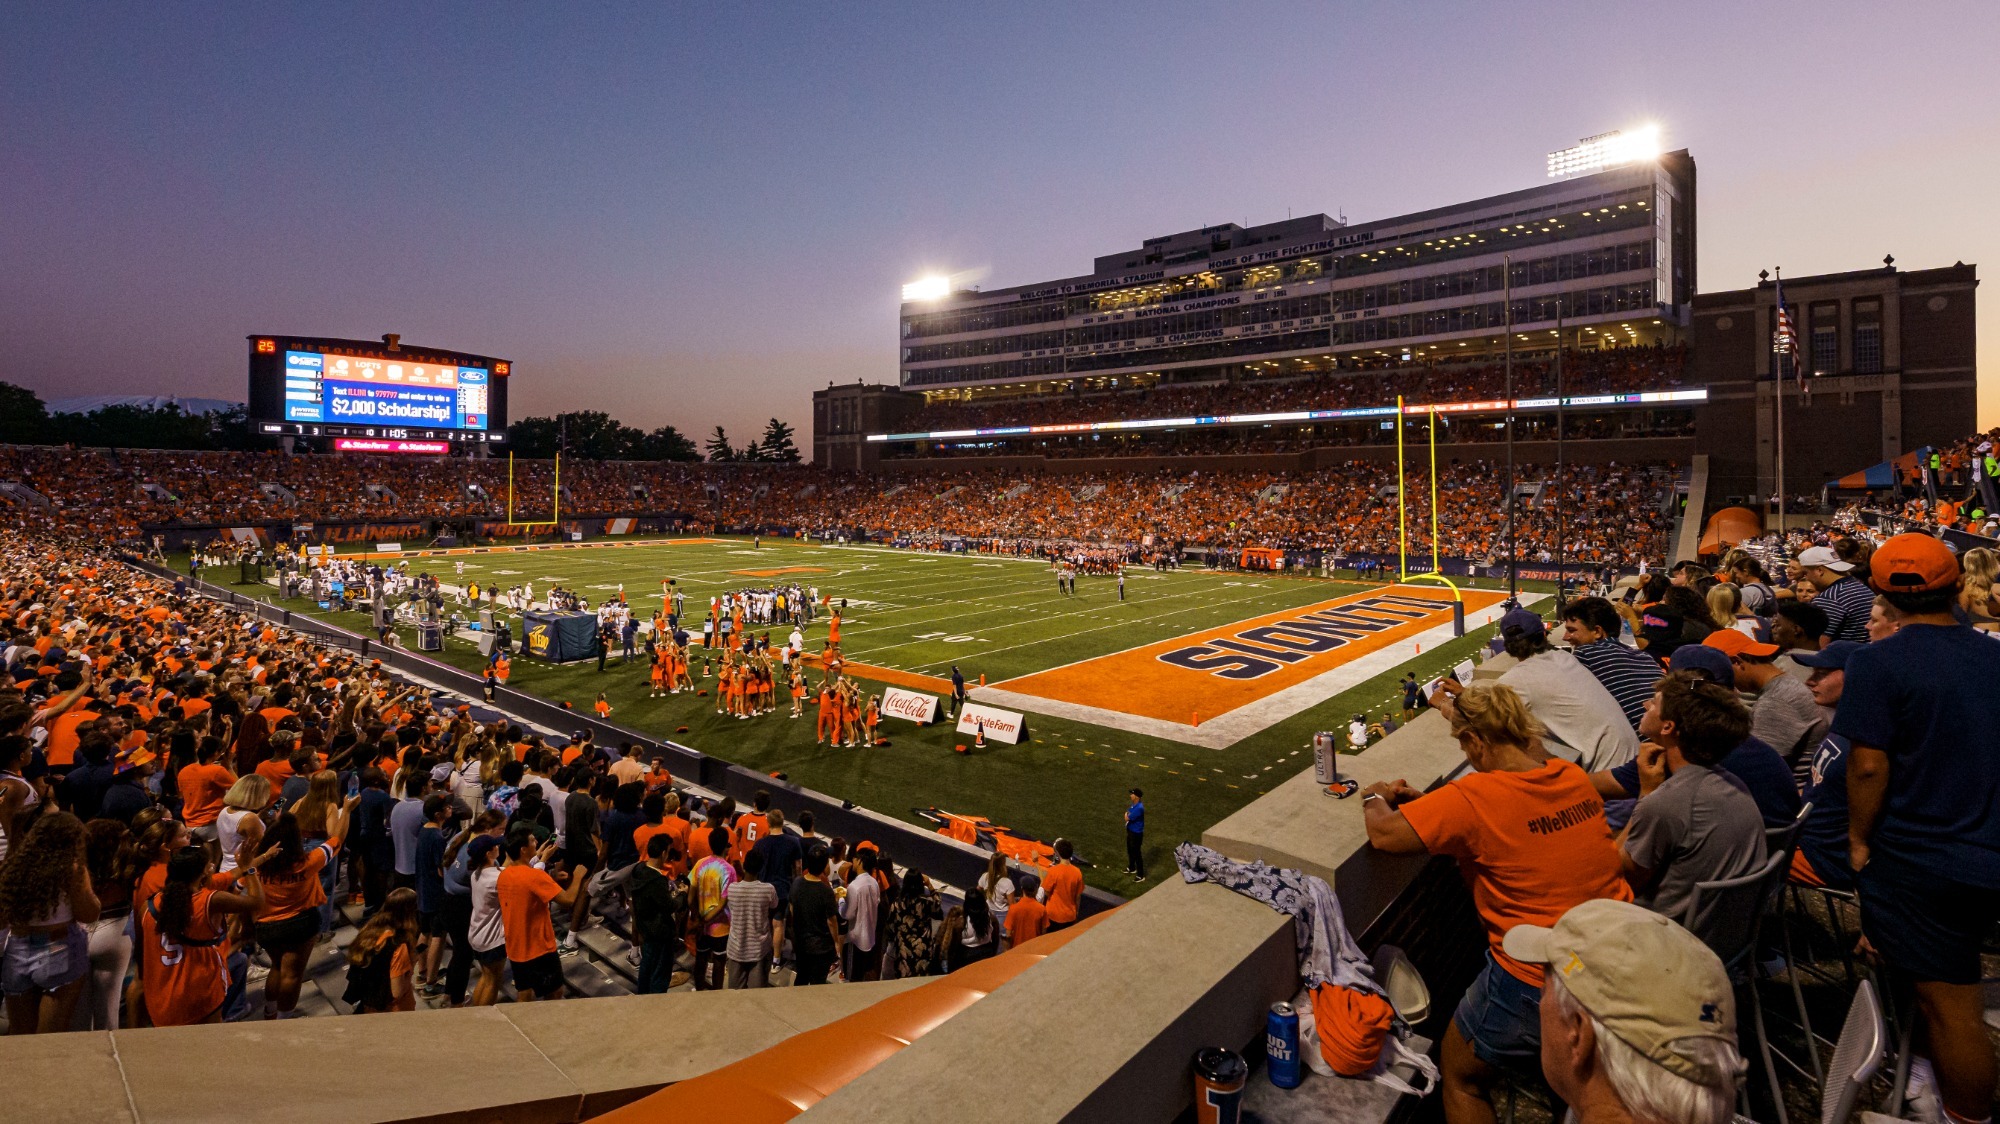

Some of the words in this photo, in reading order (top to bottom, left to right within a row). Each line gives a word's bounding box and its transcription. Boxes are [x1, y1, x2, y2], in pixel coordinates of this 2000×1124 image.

[1208, 258, 1238, 269] HOME
[1241, 255, 1255, 264] OF
[1257, 250, 1278, 261] THE
[1281, 239, 1334, 256] FIGHTING
[1338, 232, 1373, 246] ILLINI
[1020, 287, 1058, 299] WELCOME
[1061, 285, 1072, 293] TO
[1074, 278, 1120, 291] MEMORIAL
[1123, 271, 1164, 283] STADIUM
[1135, 305, 1180, 318] NATIONAL
[1183, 296, 1240, 311] CHAMPIONS
[1168, 328, 1224, 342] CHAMPIONS
[259, 341, 275, 352] 25
[291, 343, 386, 359] MEMORIAL
[407, 354, 482, 367] STADIUM
[355, 360, 381, 370] LOFTS
[495, 363, 508, 373] 25
[332, 387, 347, 396] Text
[348, 388, 366, 397] ILLINI
[375, 390, 397, 399] 979797
[332, 397, 376, 416] $2,000
[378, 402, 450, 422] Scholarship!
[296, 425, 302, 434] 7
[313, 427, 319, 435] 3
[382, 429, 407, 438] 11:05
[747, 822, 757, 841] 6
[161, 932, 183, 966] 5
[1267, 1033, 1286, 1050] UD
[1267, 1043, 1292, 1061] GHT
